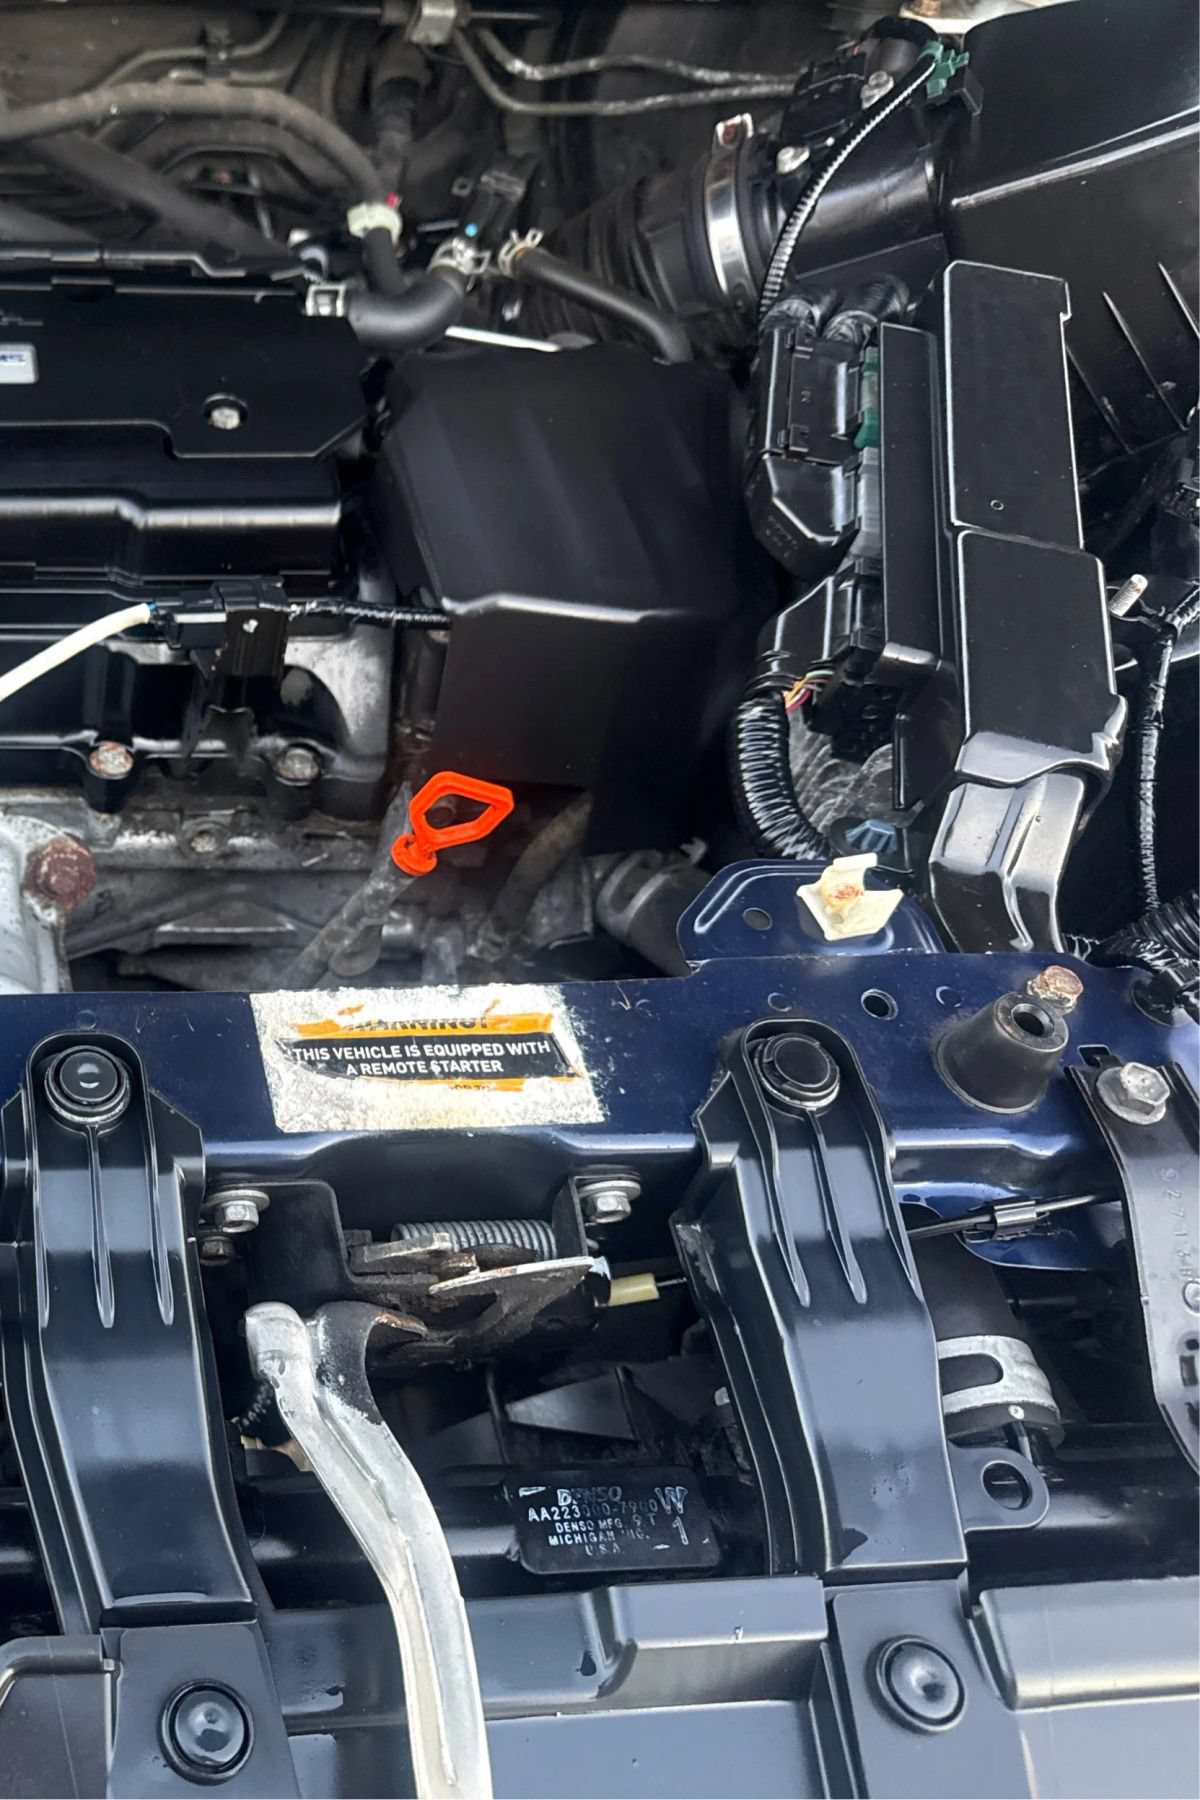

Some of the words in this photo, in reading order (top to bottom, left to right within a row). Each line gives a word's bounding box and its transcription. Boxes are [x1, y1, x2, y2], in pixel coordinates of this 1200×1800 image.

[294, 1048, 330, 1061] THIS
[332, 1045, 403, 1060] VEHICLE
[405, 1045, 421, 1057] IS
[424, 1043, 505, 1057] EQUIPPED
[505, 1040, 551, 1056] WITH
[346, 1064, 358, 1076] A
[360, 1061, 429, 1076] REMOTE
[430, 1060, 504, 1074] STARTER
[555, 1519, 595, 1534] DENSO
